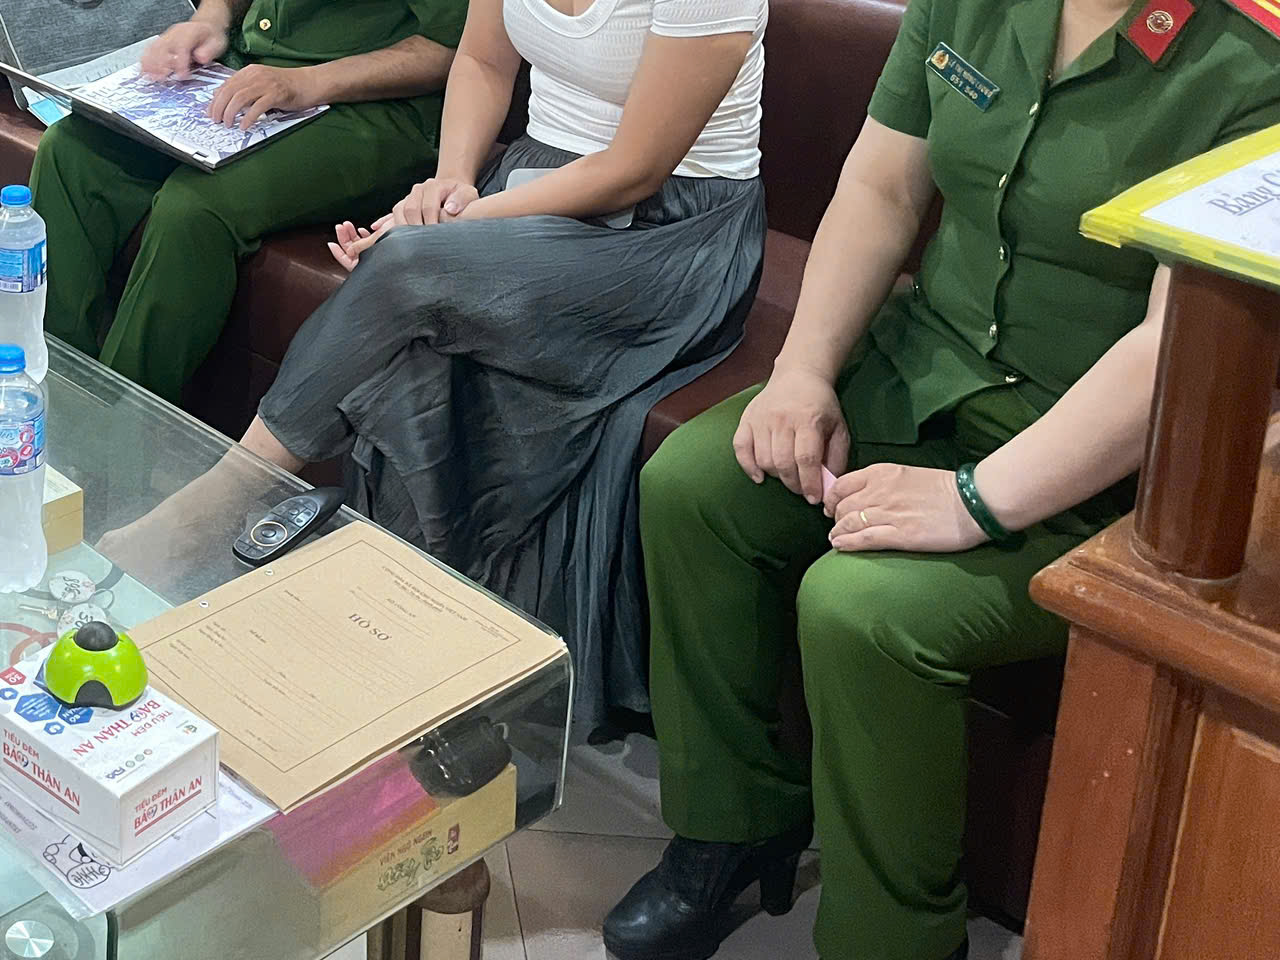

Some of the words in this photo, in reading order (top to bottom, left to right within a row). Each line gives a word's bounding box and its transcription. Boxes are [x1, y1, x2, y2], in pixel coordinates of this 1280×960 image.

[72, 741, 95, 757] AN
[31, 761, 61, 794] THẬN
[63, 788, 80, 807] AN
[160, 788, 186, 812] THẬN
[188, 776, 203, 792] AN
